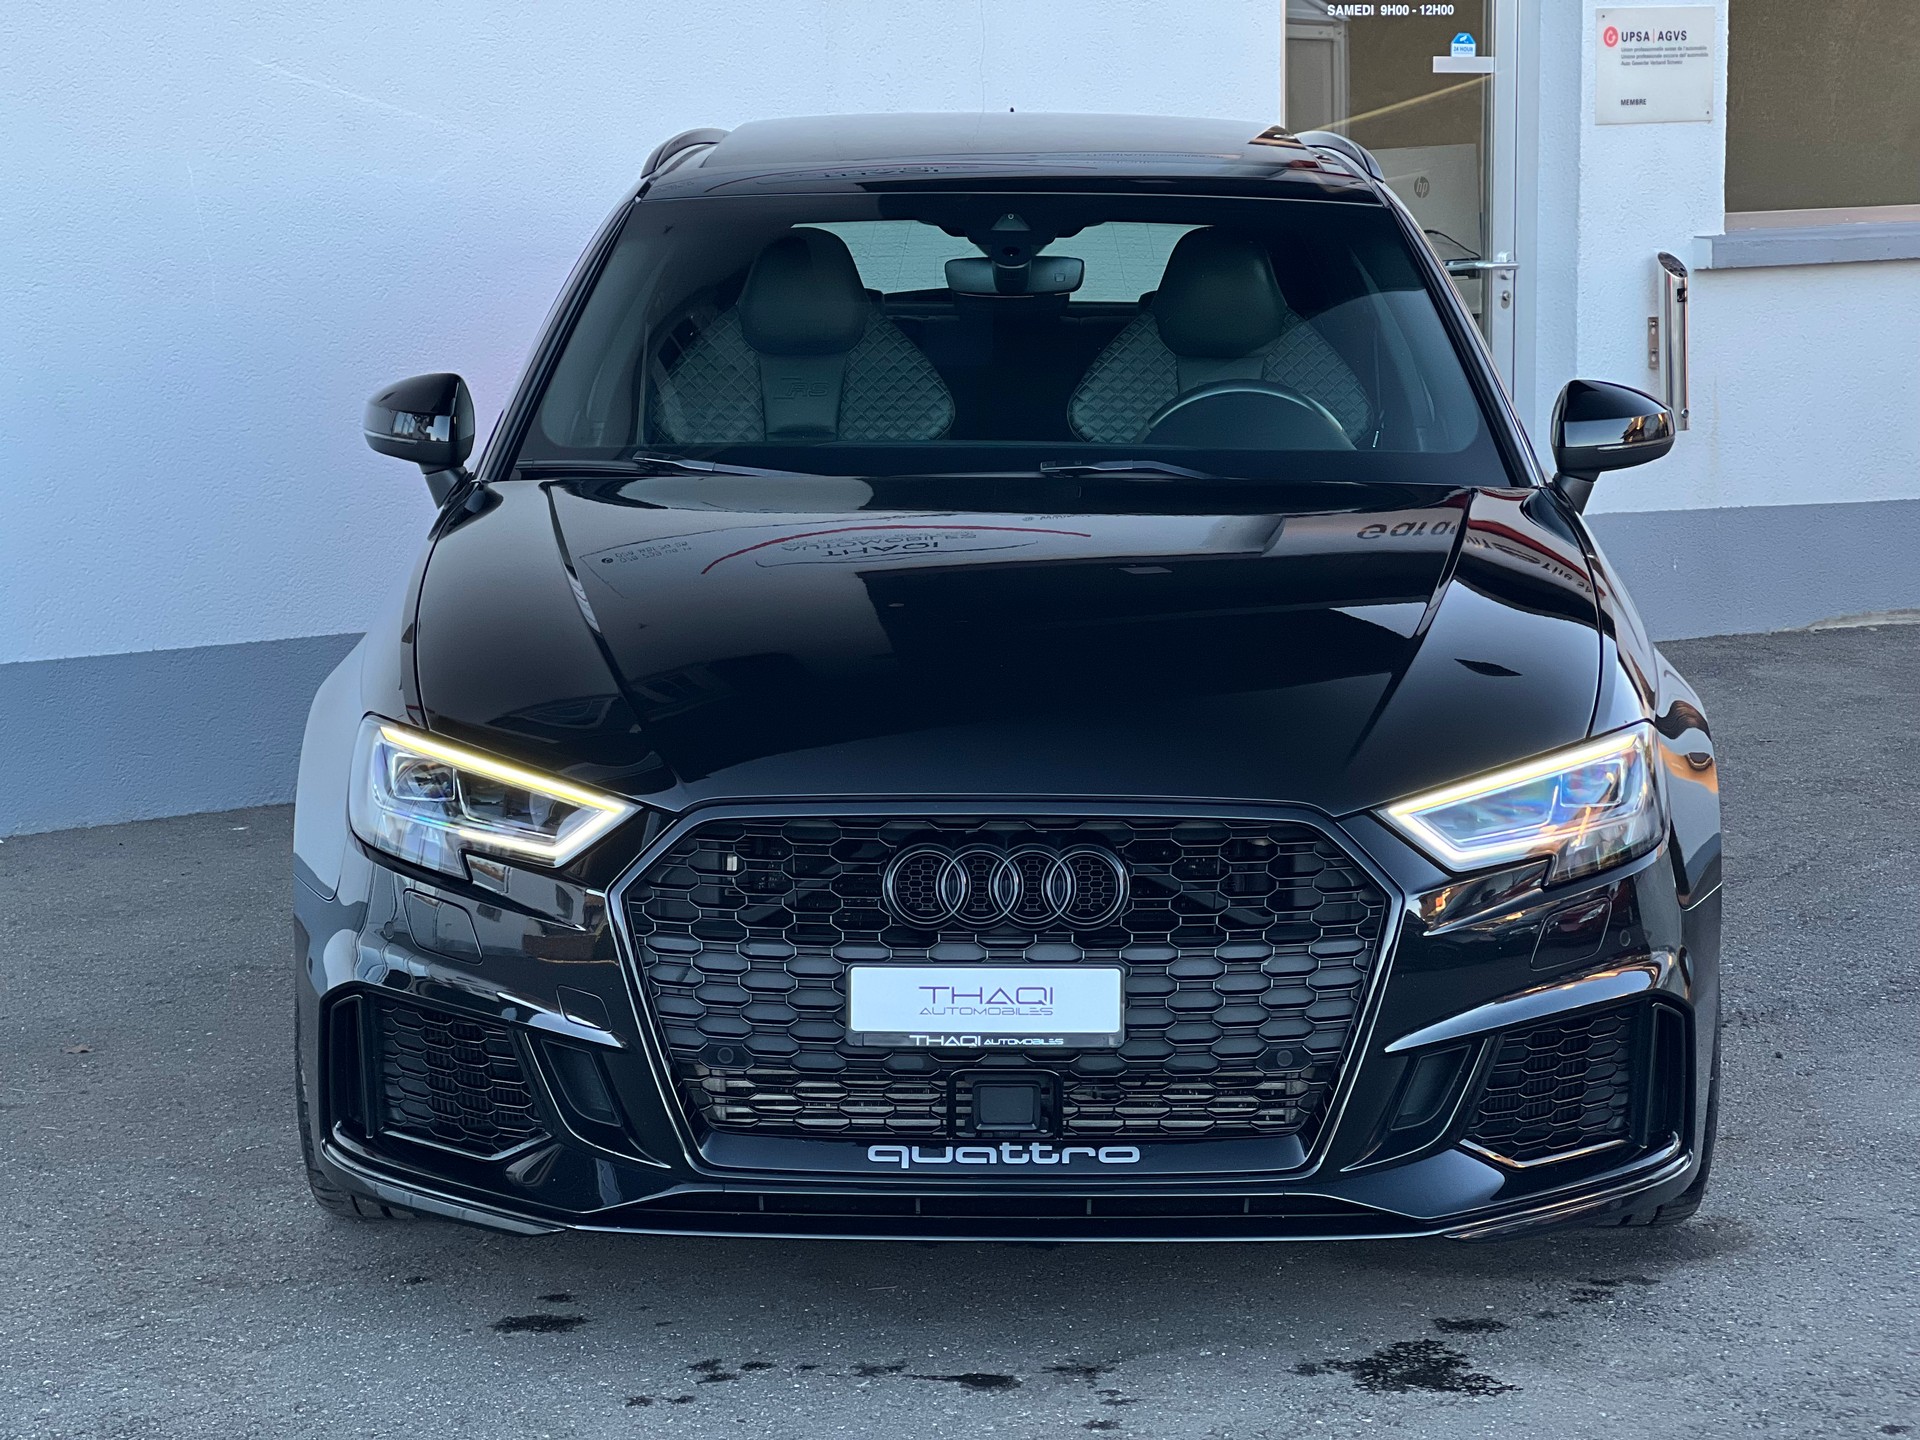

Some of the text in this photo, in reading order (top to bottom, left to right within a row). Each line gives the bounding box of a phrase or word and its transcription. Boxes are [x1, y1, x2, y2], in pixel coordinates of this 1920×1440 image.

[1327, 4, 1374, 16] SAMEDI
[1380, 4, 1410, 16] 9H00
[1419, 4, 1455, 16] 12H00
[1621, 30, 1687, 42] UPSA AGVS
[1620, 98, 1647, 106] MEMBRE
[1415, 176, 1429, 198] hp
[918, 986, 1054, 1005] THAQI
[919, 1007, 1054, 1016] AUTOMOBILES
[909, 1034, 1064, 1047] THAQI AUTOMOBILES
[867, 1142, 1141, 1169] quattro
